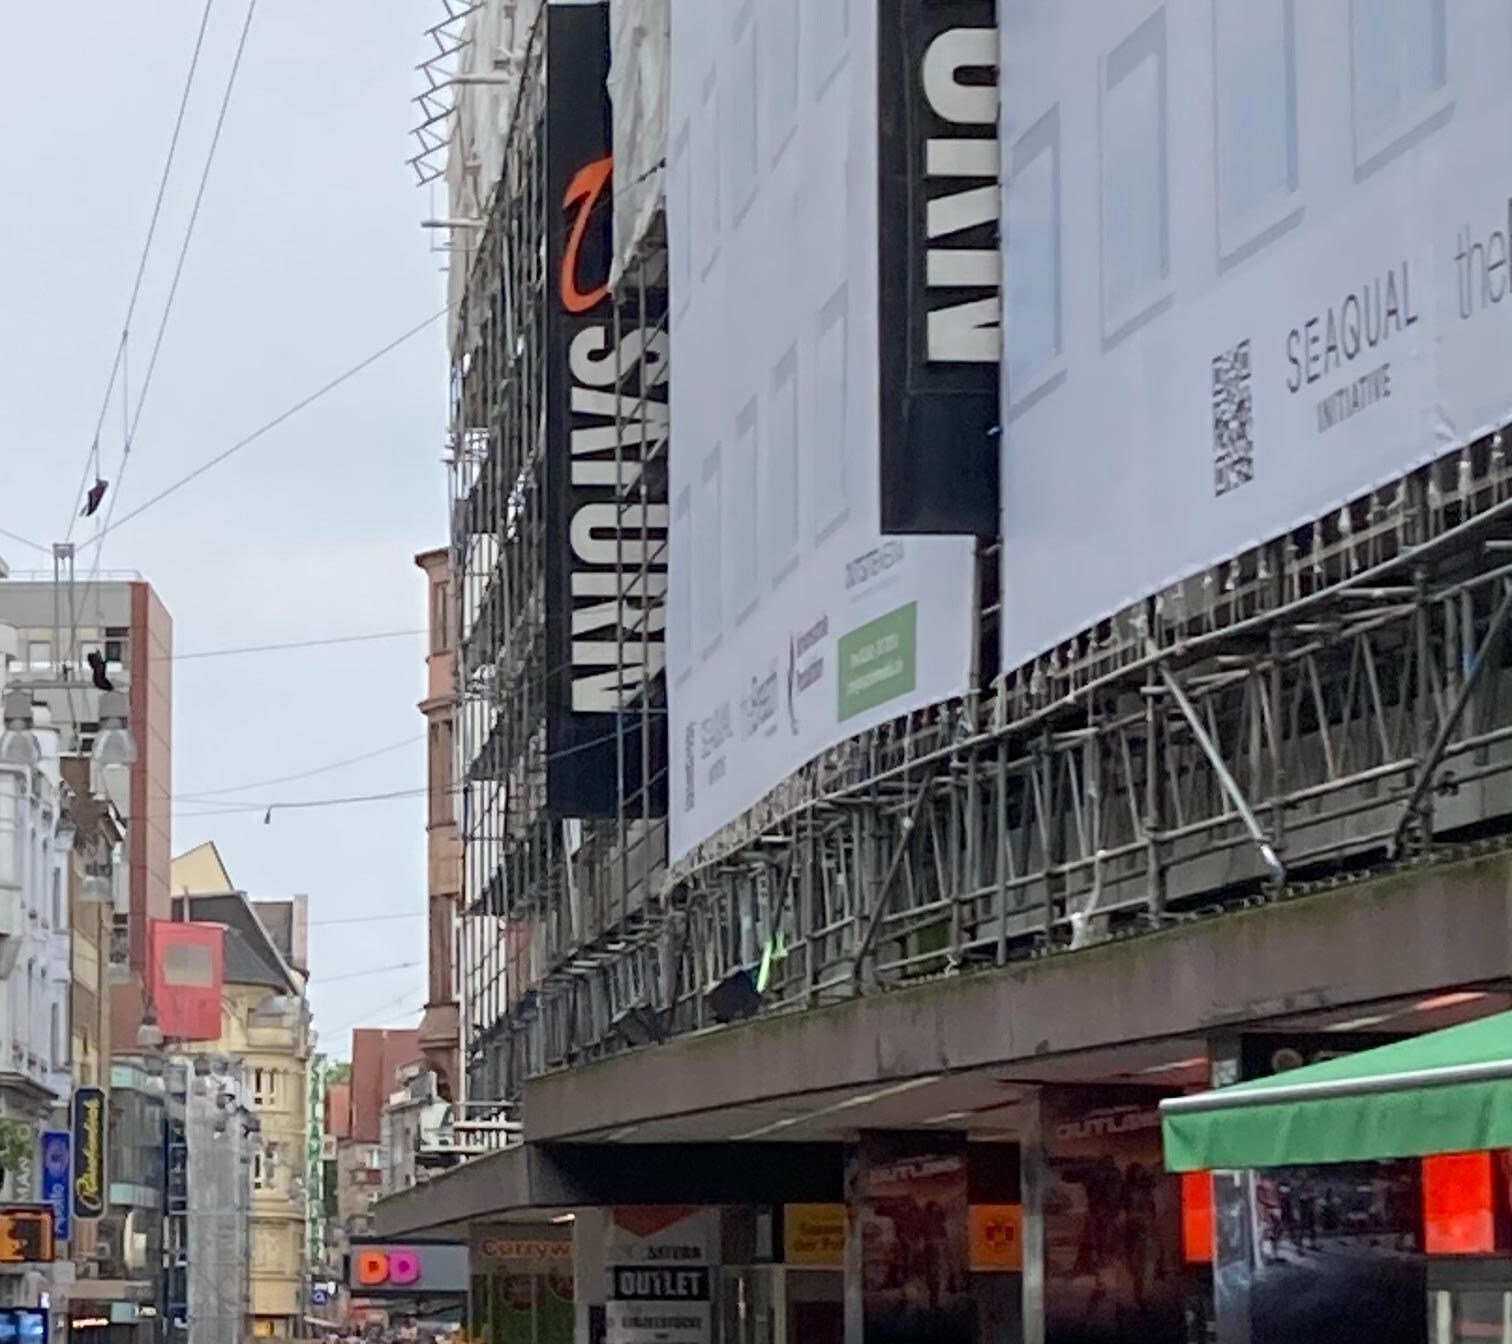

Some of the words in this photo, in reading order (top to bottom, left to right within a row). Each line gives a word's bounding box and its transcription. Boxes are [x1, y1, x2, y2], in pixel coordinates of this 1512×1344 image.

[1285, 260, 1419, 394] SEAQUAL
[1316, 361, 1392, 435] INITIATIVE
[15, 1124, 32, 1202] MANO
[619, 1270, 703, 1297] OUTLET
